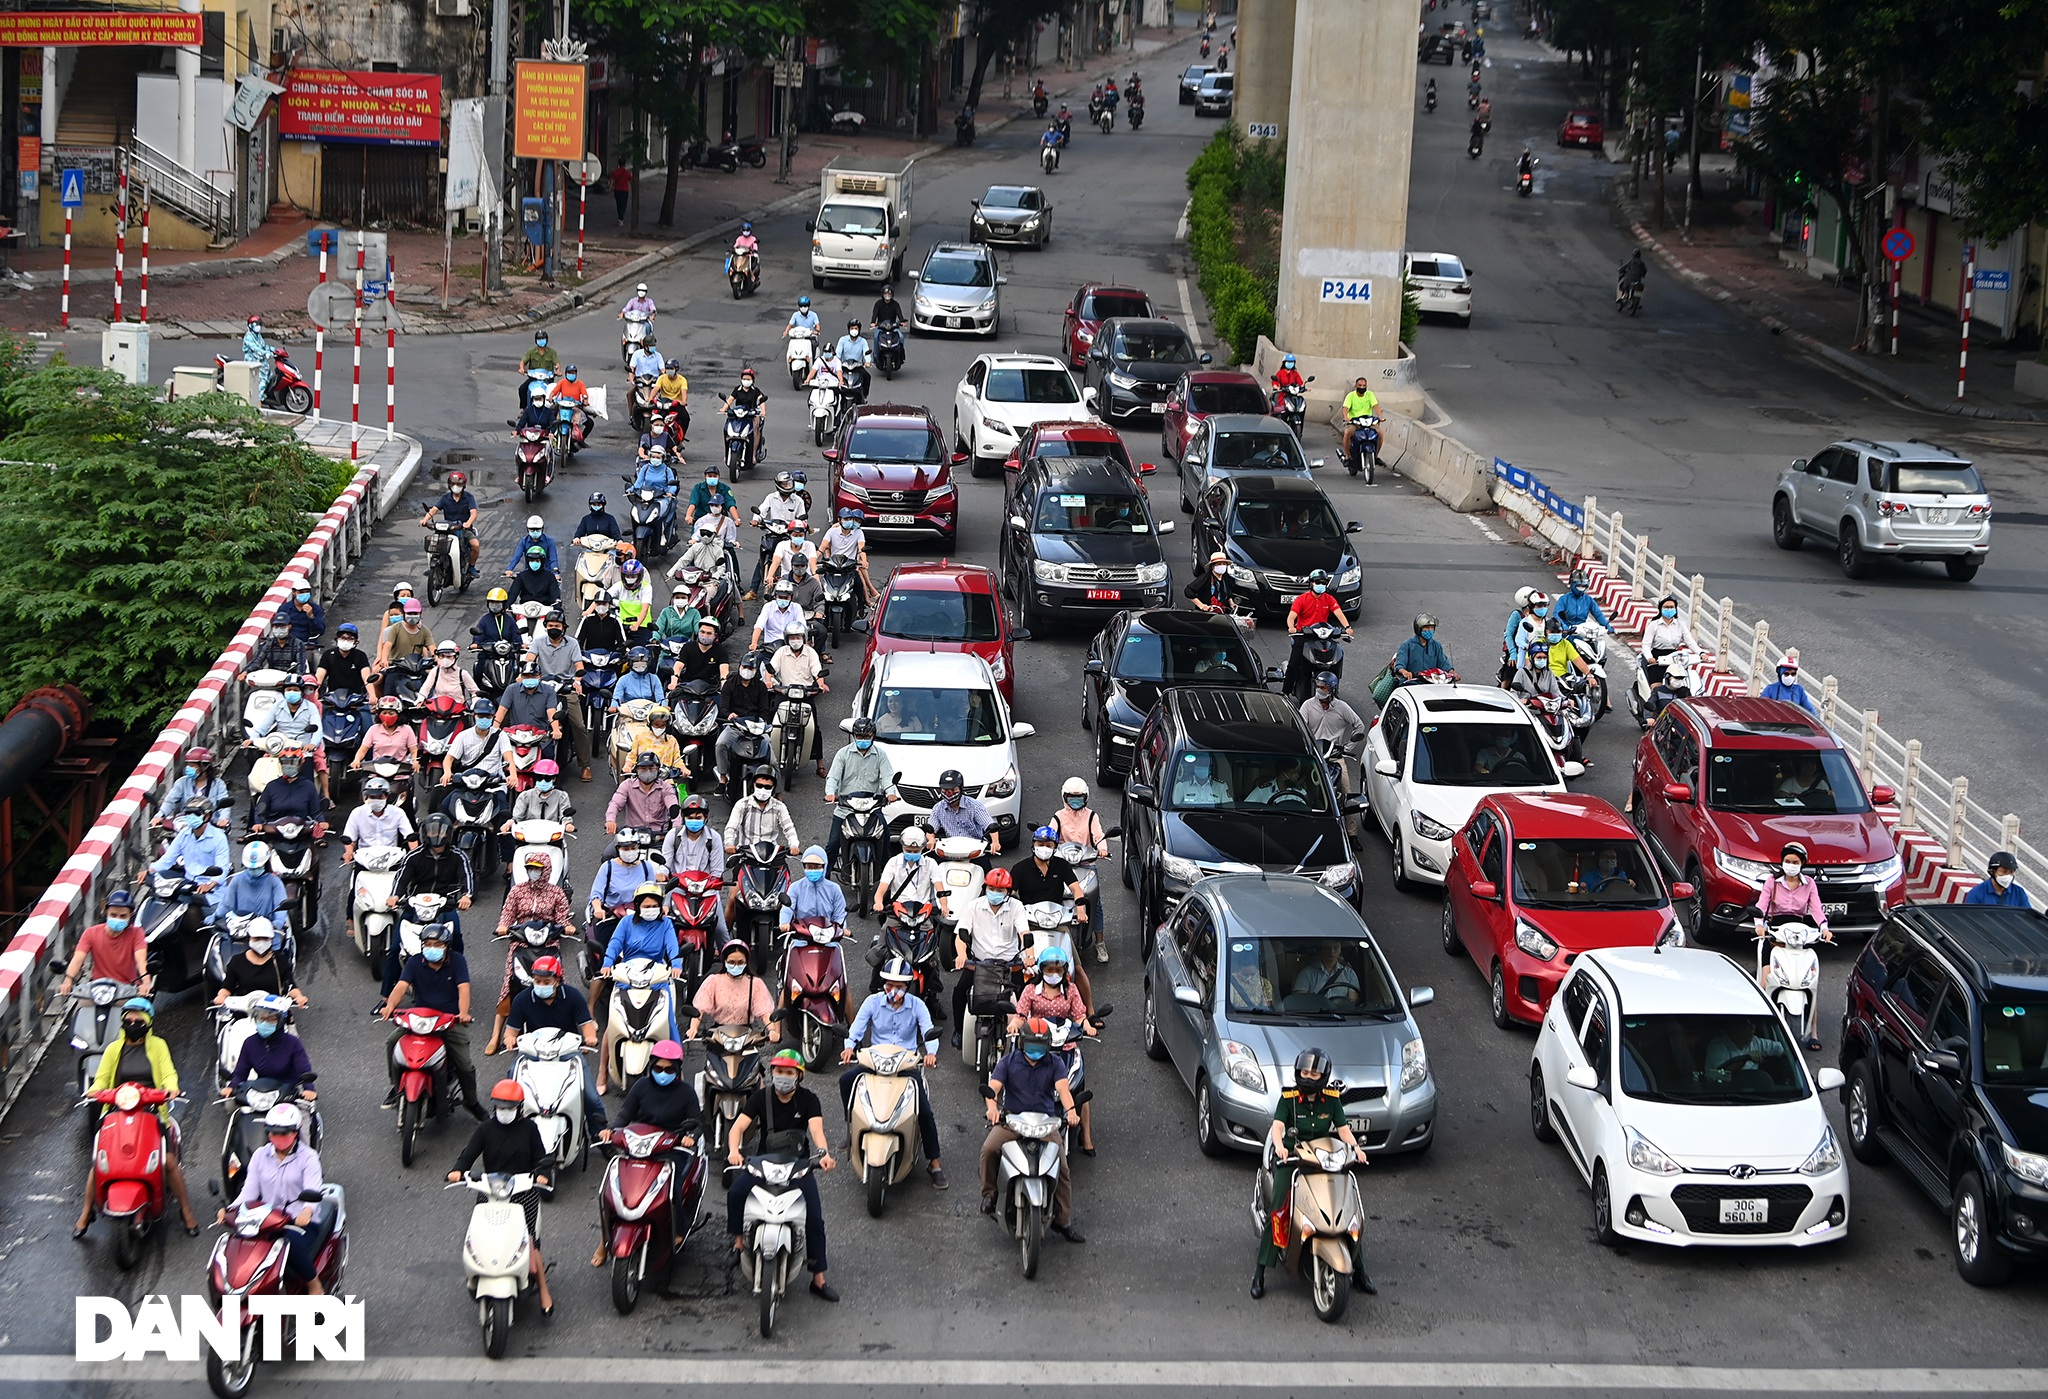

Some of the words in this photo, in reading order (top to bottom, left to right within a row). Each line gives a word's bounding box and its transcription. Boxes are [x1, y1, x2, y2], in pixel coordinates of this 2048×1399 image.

[43, 16, 63, 28] NGÀY
[150, 17, 164, 30] HỘI
[187, 18, 196, 28] XV
[2, 30, 15, 43] HỘI
[40, 30, 61, 41] NHÂN
[63, 30, 79, 41] DÂN
[81, 30, 96, 41] CÁC
[292, 82, 318, 94] CHĂM
[321, 83, 339, 95] SÓC
[341, 84, 358, 96] TÓC
[396, 87, 414, 98] SÓC
[416, 89, 428, 99] DA
[297, 111, 322, 122] TRANG
[1250, 124, 1277, 137] P343
[1322, 281, 1370, 300] P344
[1734, 1200, 1755, 1211] 30G
[1724, 1211, 1763, 1222] 560.18
